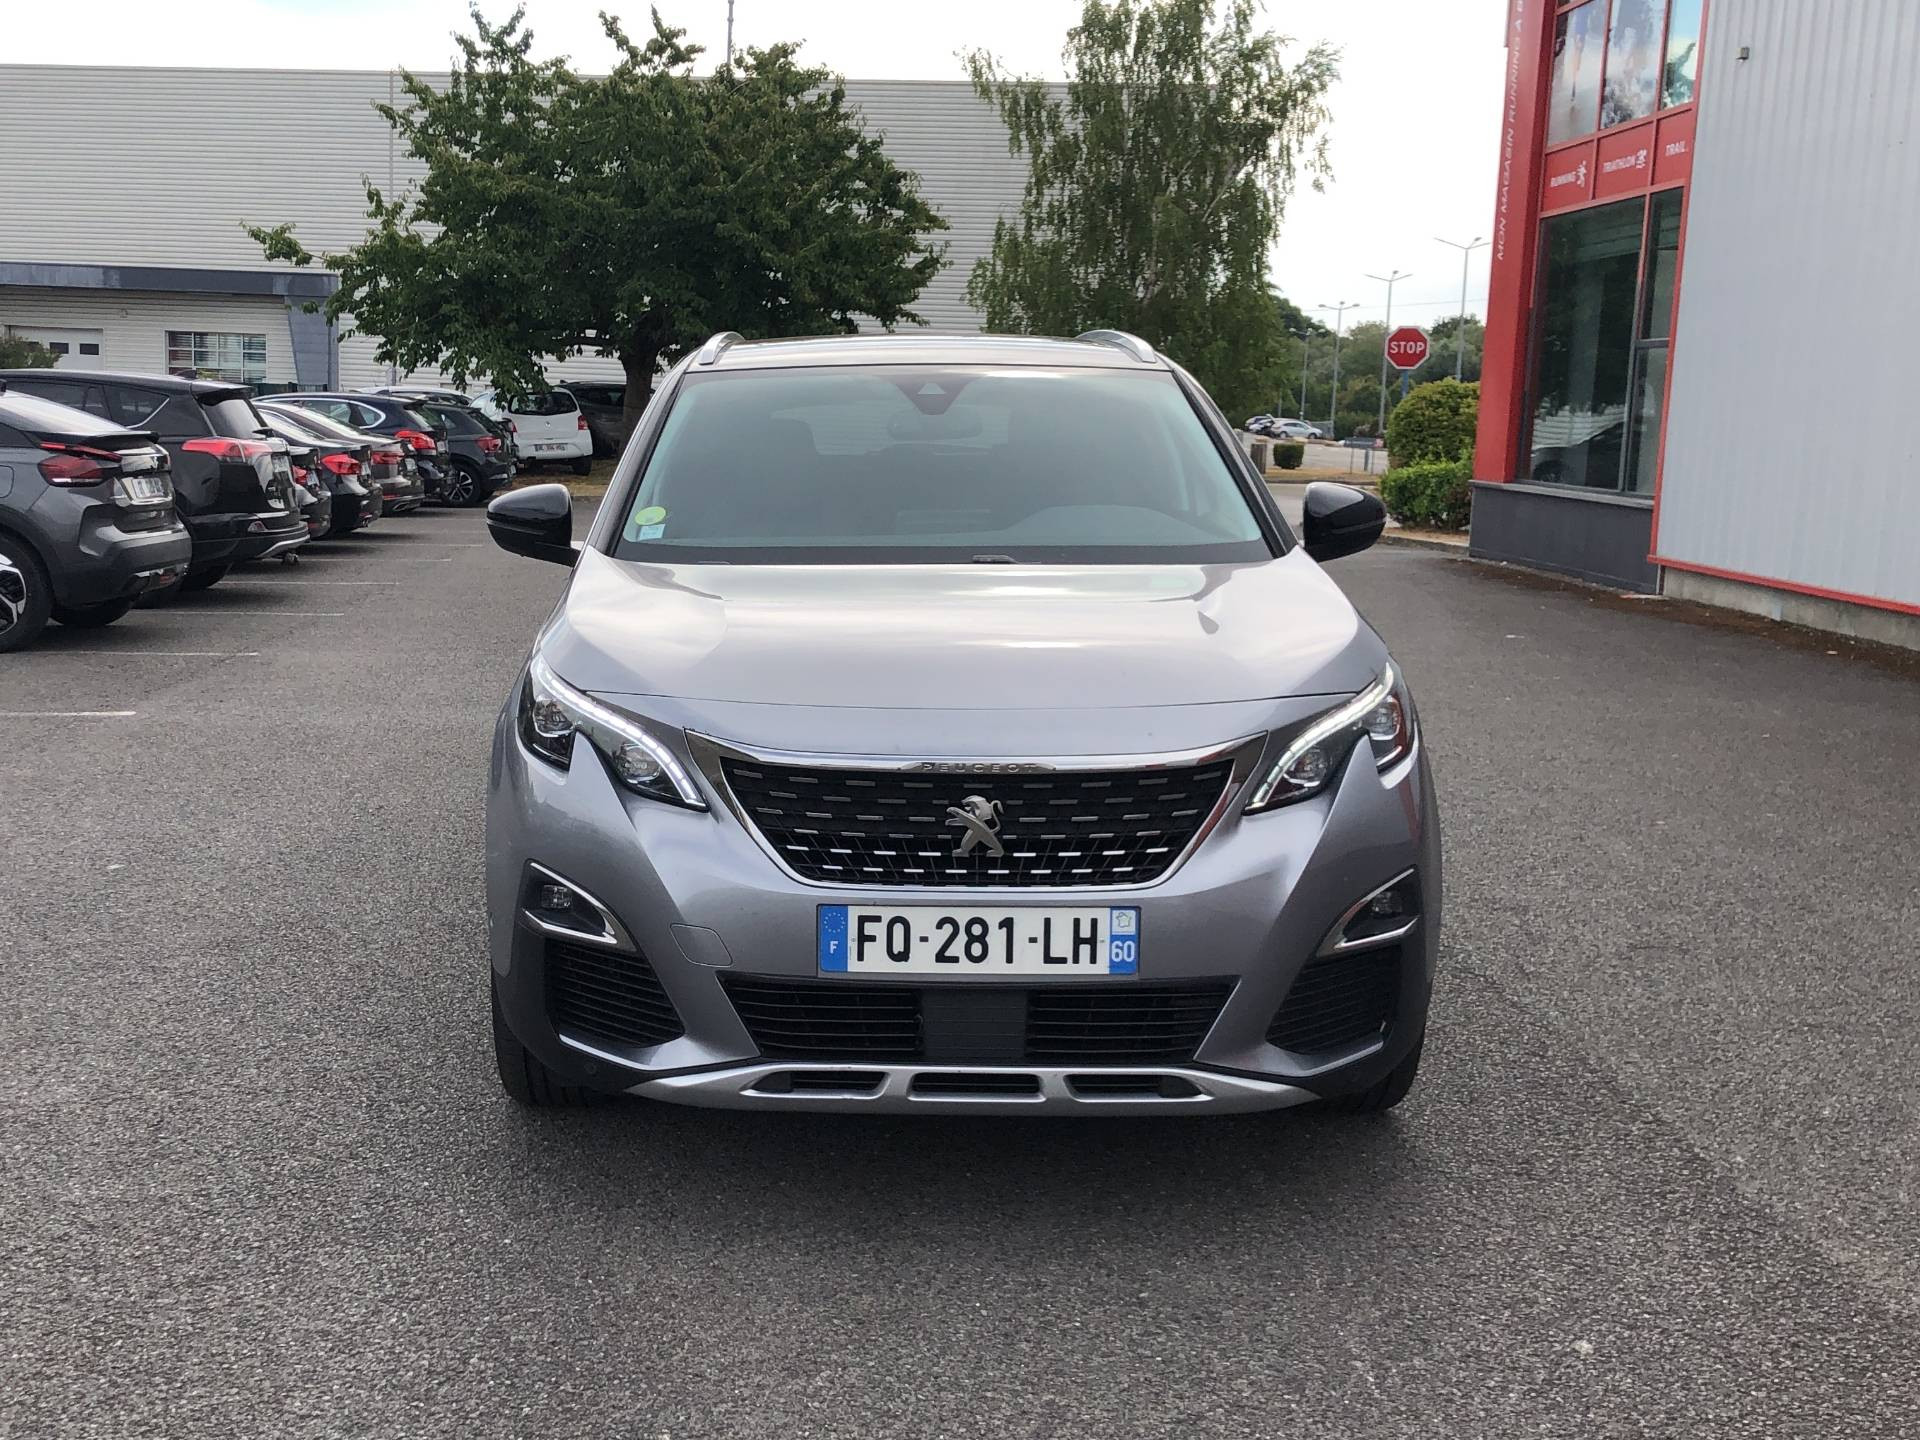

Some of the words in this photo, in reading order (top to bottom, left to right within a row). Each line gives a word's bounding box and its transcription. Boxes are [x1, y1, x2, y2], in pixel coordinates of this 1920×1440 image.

[1510, 36, 1521, 123] RUNNING
[1501, 127, 1514, 213] MAGASIN
[1496, 217, 1507, 261] MON
[1390, 341, 1425, 354] STOP
[920, 761, 1038, 774] PEUGEOT
[829, 940, 838, 954] F
[856, 914, 1098, 965] FQ-281-LH
[1110, 940, 1136, 962] 60
